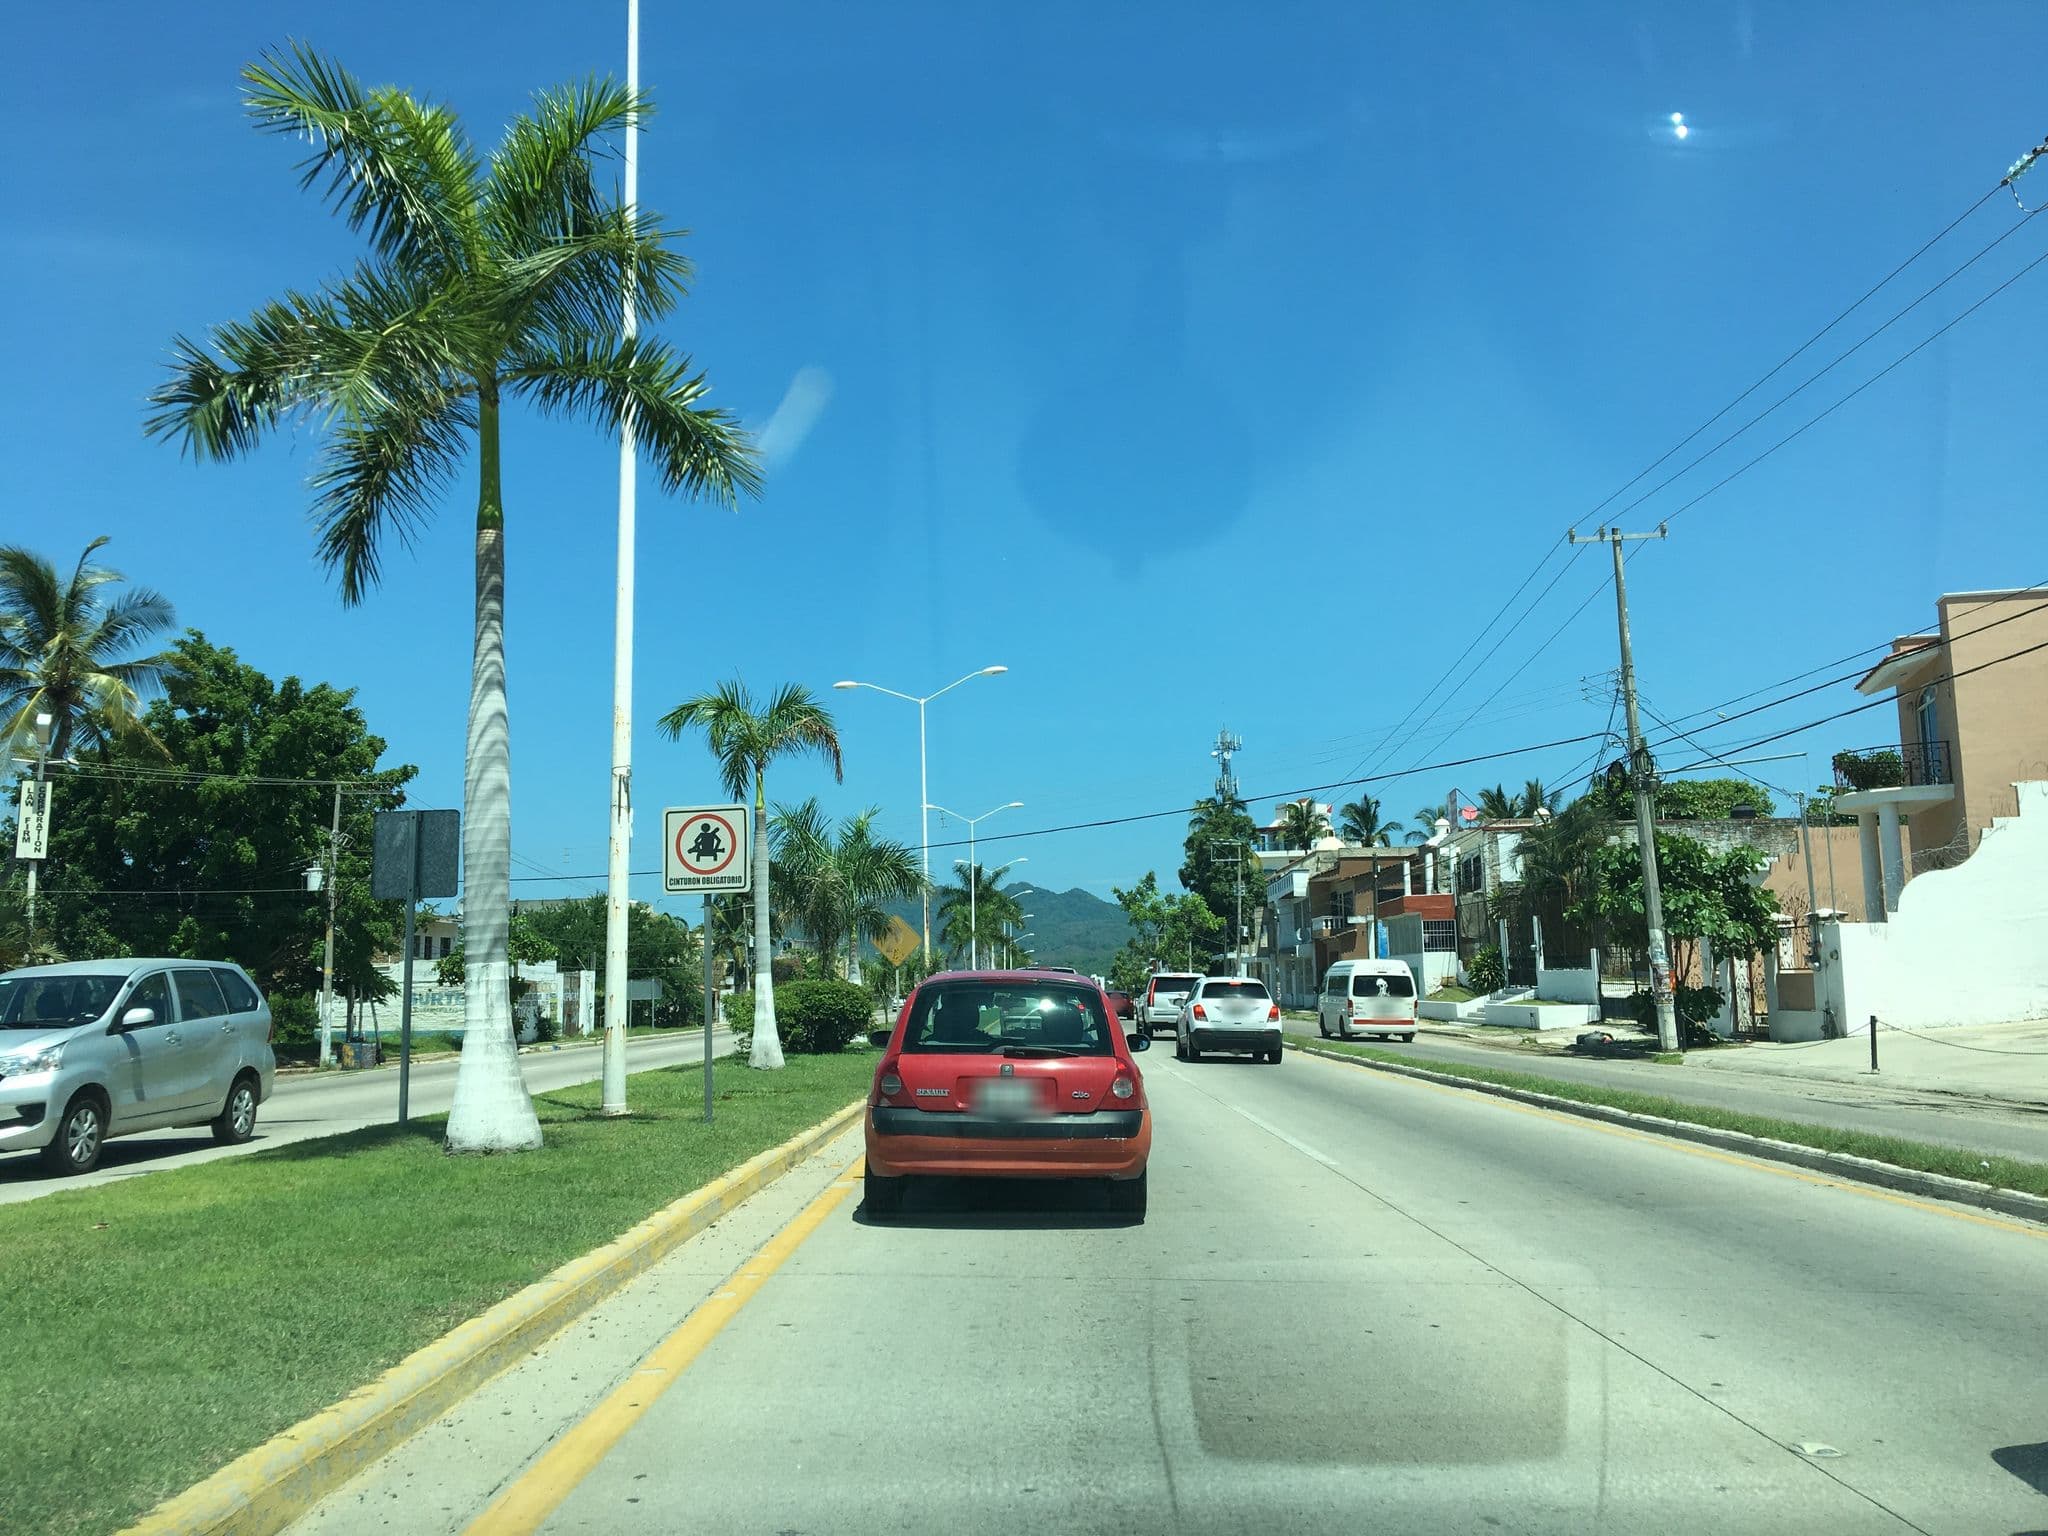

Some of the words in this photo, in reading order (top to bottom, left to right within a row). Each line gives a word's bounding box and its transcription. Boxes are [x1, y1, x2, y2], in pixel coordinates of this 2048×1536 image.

[25, 787, 34, 807] LAW
[22, 817, 31, 843] FIRM
[34, 786, 46, 853] CORPORATION
[669, 877, 701, 886] CINTURON
[701, 875, 742, 885] OBLIGATORIO
